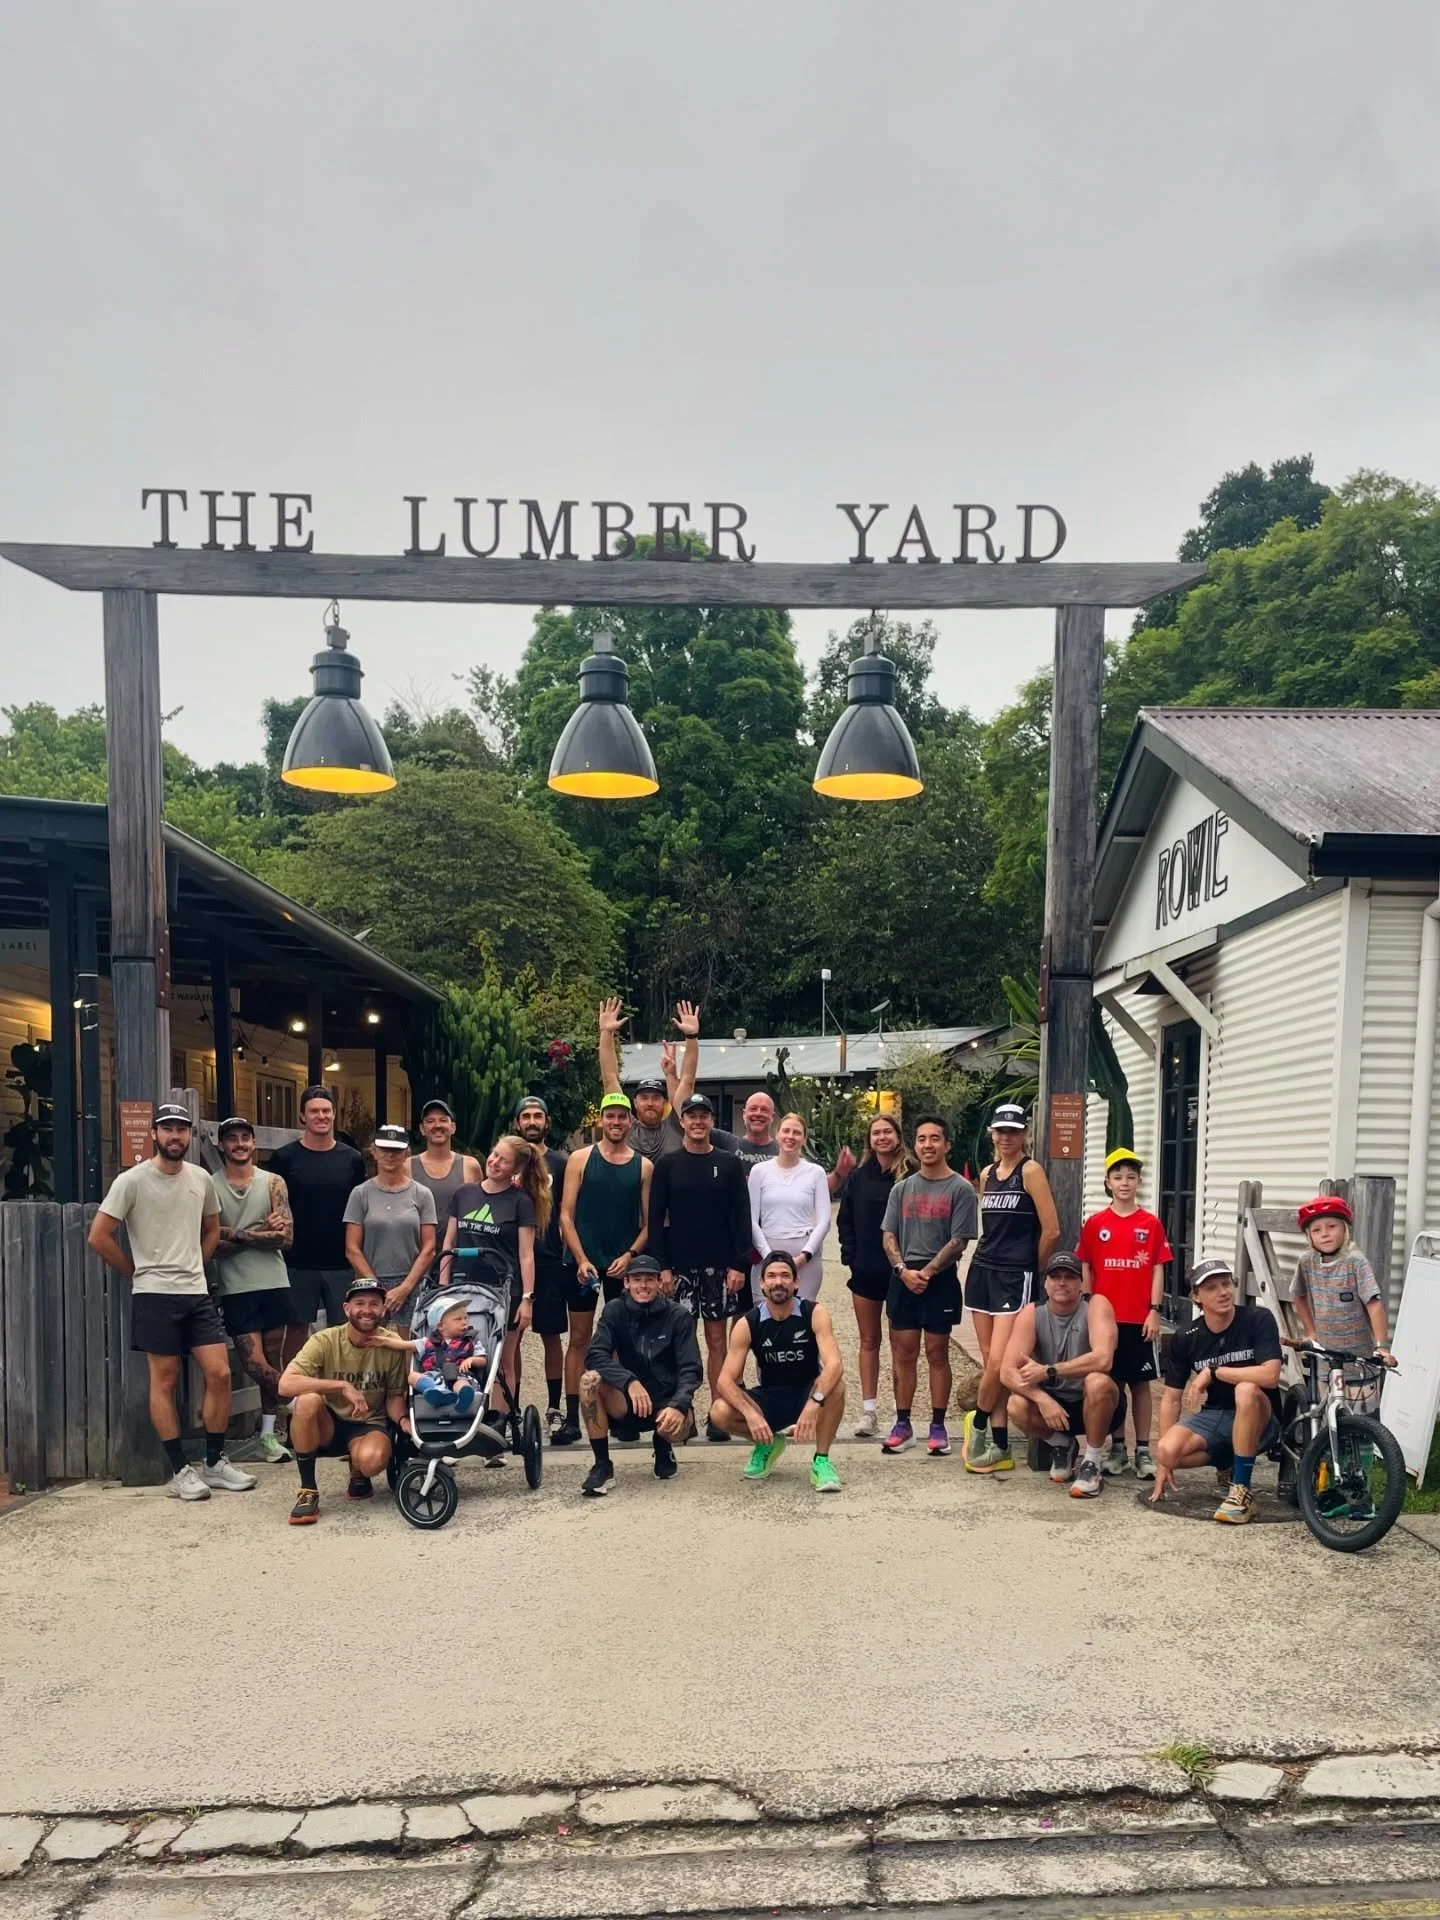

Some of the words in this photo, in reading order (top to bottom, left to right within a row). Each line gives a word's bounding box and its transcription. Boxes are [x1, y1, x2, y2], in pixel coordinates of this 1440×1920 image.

[142, 489, 313, 553] THE
[403, 496, 756, 562] LUMBER
[836, 503, 1067, 564] YARD
[1156, 808, 1229, 930] ROWIE
[470, 1222, 483, 1231] THE
[483, 1225, 501, 1235] HIGH
[1103, 1258, 1140, 1269] mara
[764, 1349, 805, 1363] INEOS
